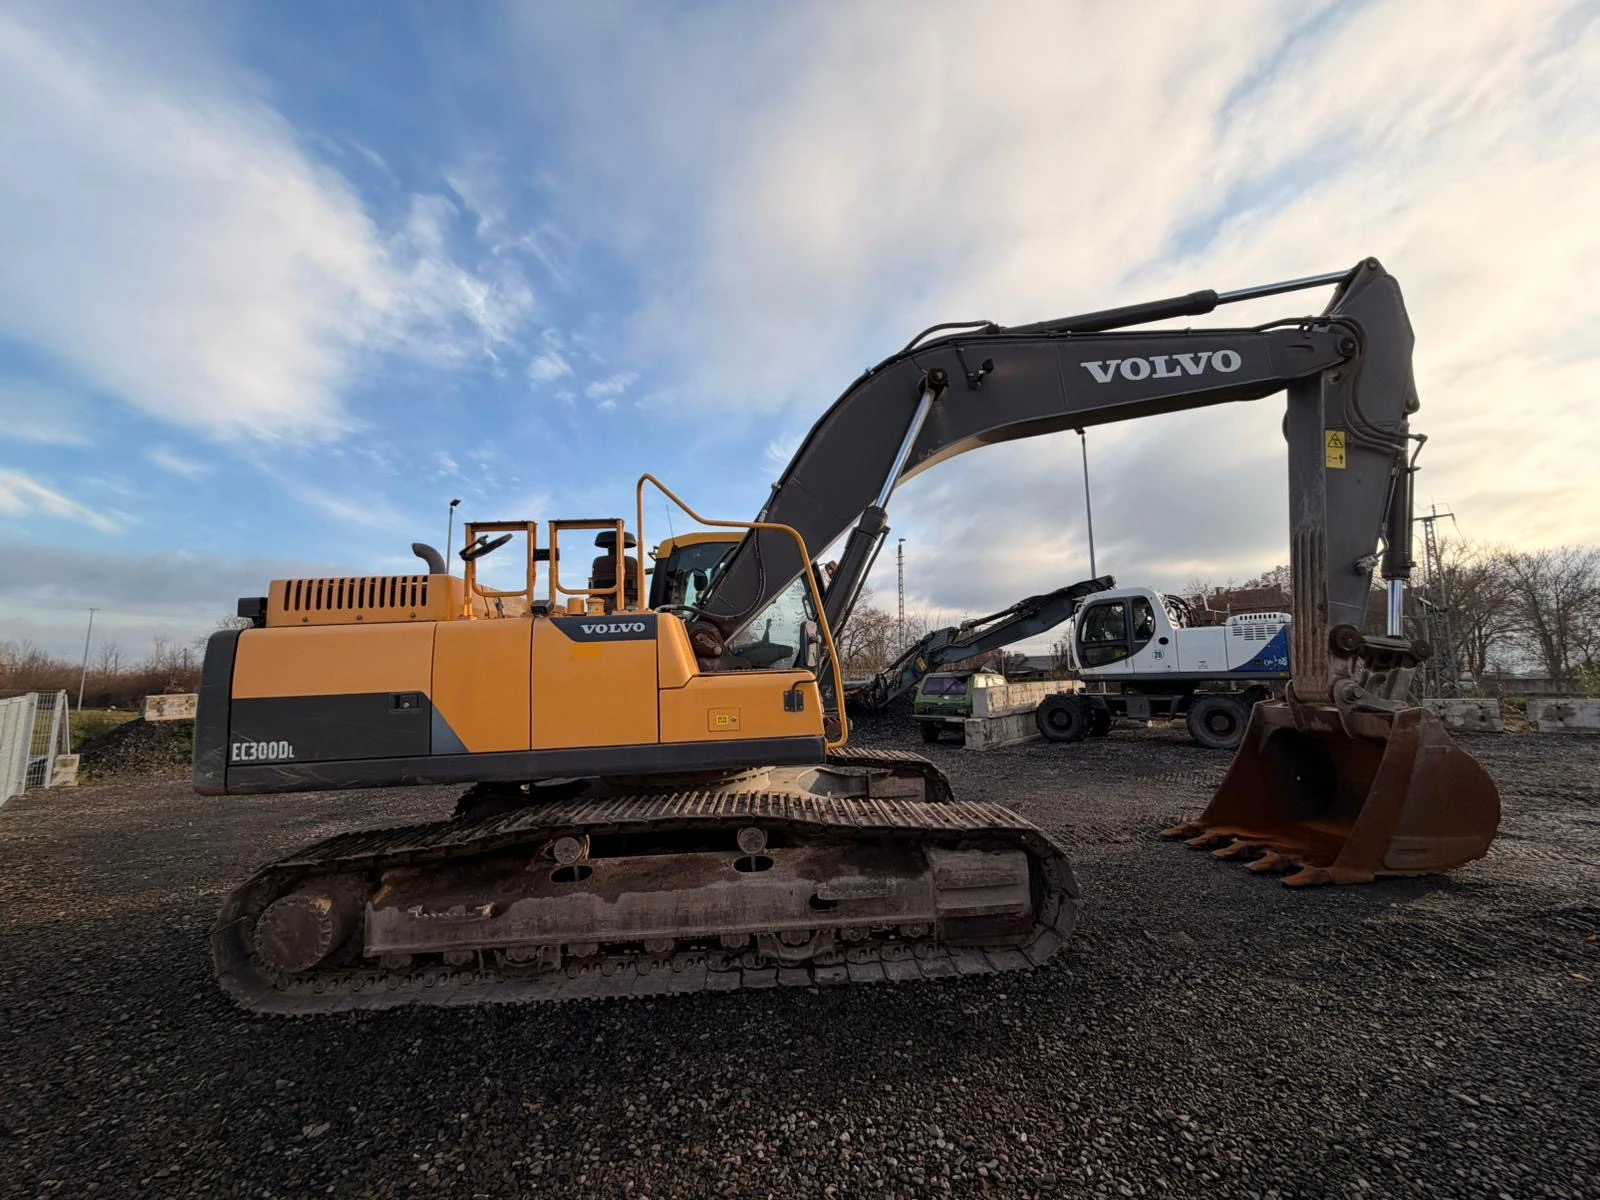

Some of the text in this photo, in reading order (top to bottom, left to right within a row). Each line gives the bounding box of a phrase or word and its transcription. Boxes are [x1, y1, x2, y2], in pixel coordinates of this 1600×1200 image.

[1080, 349, 1242, 384] VOLVO
[580, 622, 646, 634] VOLVO
[232, 741, 295, 761] EC300DL
